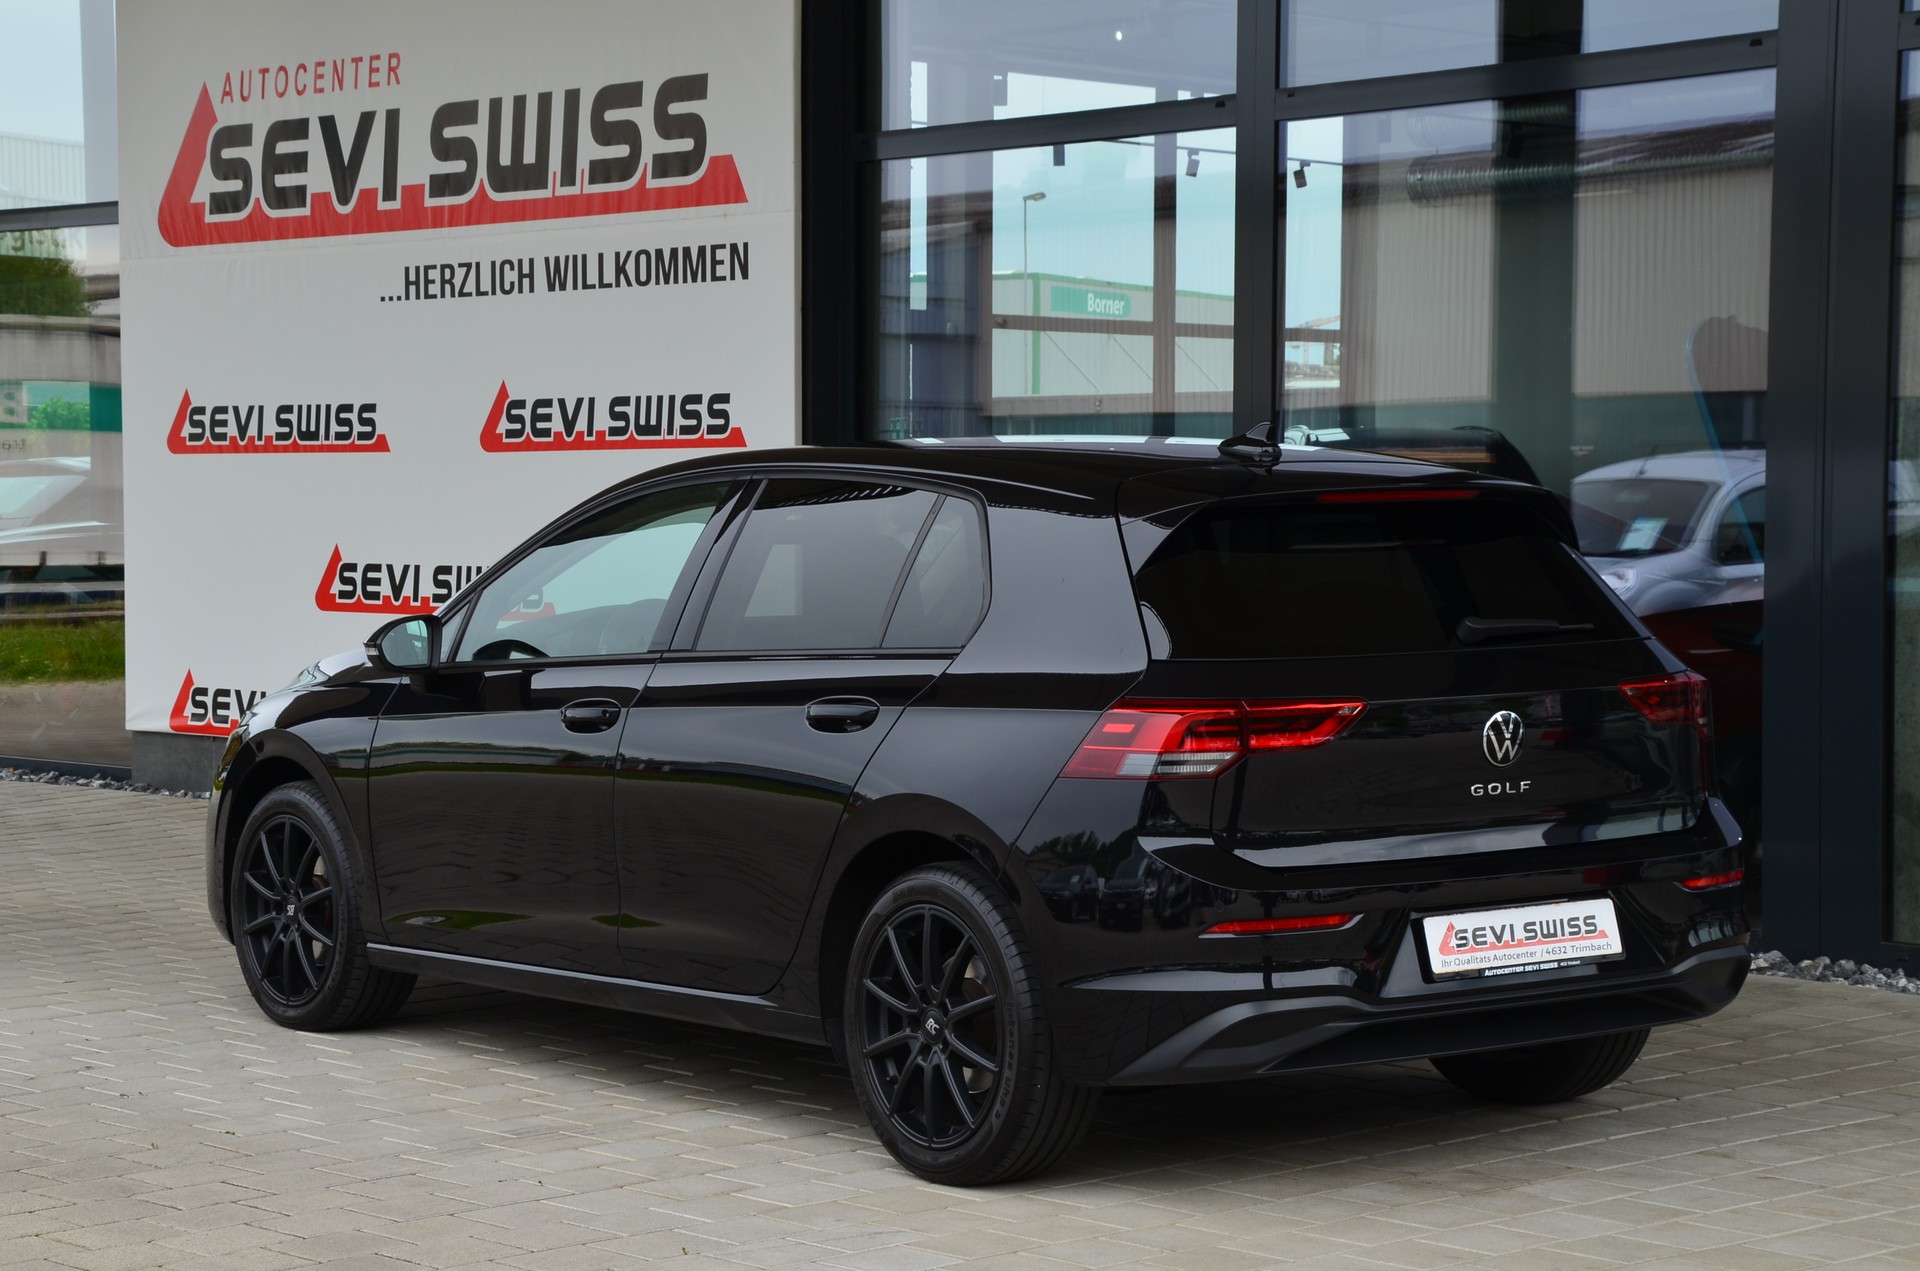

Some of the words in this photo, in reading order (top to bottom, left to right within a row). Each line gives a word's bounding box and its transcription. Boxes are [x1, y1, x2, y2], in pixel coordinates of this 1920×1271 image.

[222, 52, 401, 102] AUTOCENTER
[208, 109, 401, 215] SEVI
[428, 73, 709, 199] SWISS
[544, 242, 749, 293] WILLKOMMEN
[1087, 293, 1125, 316] Borner
[188, 405, 265, 442] SEVI
[274, 403, 377, 442] SWISS
[504, 396, 596, 440] SEVI
[607, 392, 731, 437] SWISS
[337, 562, 421, 603] SEVI
[190, 686, 268, 726] SEV
[1470, 780, 1532, 798] GOLF
[1454, 923, 1517, 949] SEVI
[1523, 915, 1598, 941] SWISS
[1493, 949, 1538, 962] Autocenter
[1546, 945, 1568, 956] 4632
[1570, 941, 1612, 954] Trimbach
